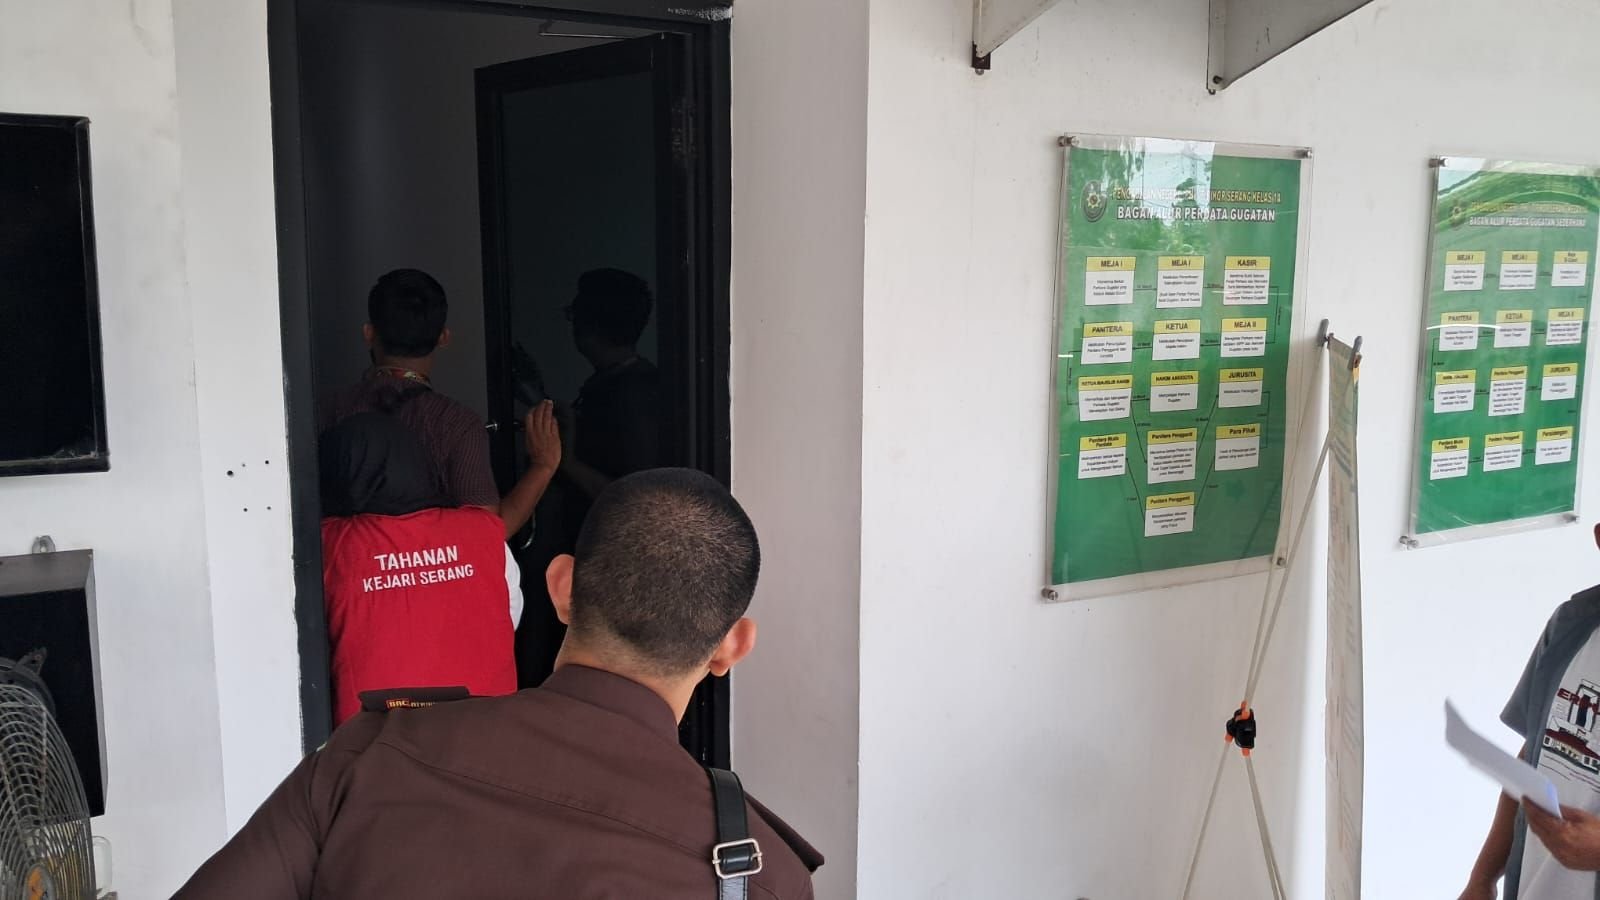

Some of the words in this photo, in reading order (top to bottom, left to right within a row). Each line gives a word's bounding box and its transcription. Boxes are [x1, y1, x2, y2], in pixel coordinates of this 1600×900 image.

[1227, 190, 1251, 203] SERANG
[1252, 191, 1272, 204] KELAS
[1117, 206, 1152, 219] BAGAN
[1184, 207, 1228, 221] PERDATA
[1230, 208, 1276, 221] GUGATAN
[1101, 260, 1120, 268] MEJA
[1171, 259, 1188, 267] MEJA
[1237, 259, 1257, 267] KASIR
[1505, 312, 1523, 320] KETUA
[1091, 325, 1123, 333] PANITERA
[1165, 322, 1189, 331] KETUA
[1233, 320, 1251, 329] MEJA
[1228, 370, 1257, 379] JURUSITA
[374, 545, 458, 571] TAHANAN
[362, 572, 417, 593] KEJARI
[419, 564, 475, 585] SERANG
